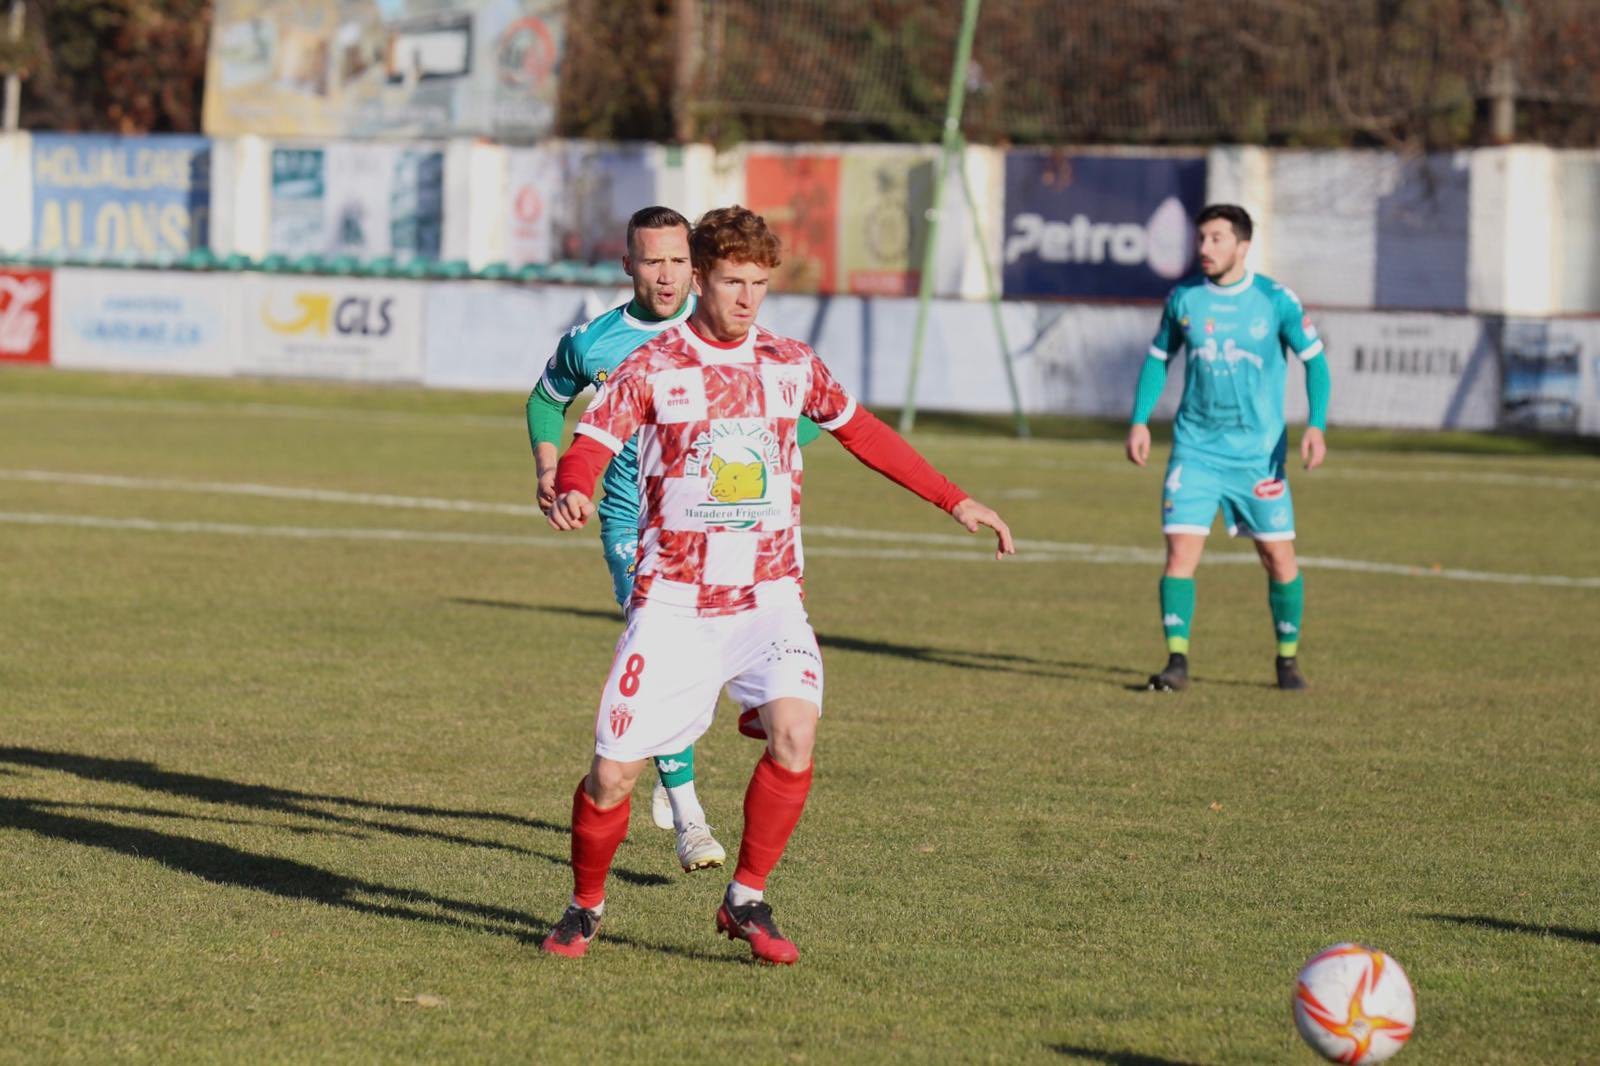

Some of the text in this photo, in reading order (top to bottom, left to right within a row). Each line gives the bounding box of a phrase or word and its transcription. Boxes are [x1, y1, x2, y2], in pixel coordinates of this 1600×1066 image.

[1004, 213, 1149, 265] Petro
[335, 295, 393, 335] GLS
[685, 508, 733, 519] Matadero
[619, 653, 645, 697] 8
